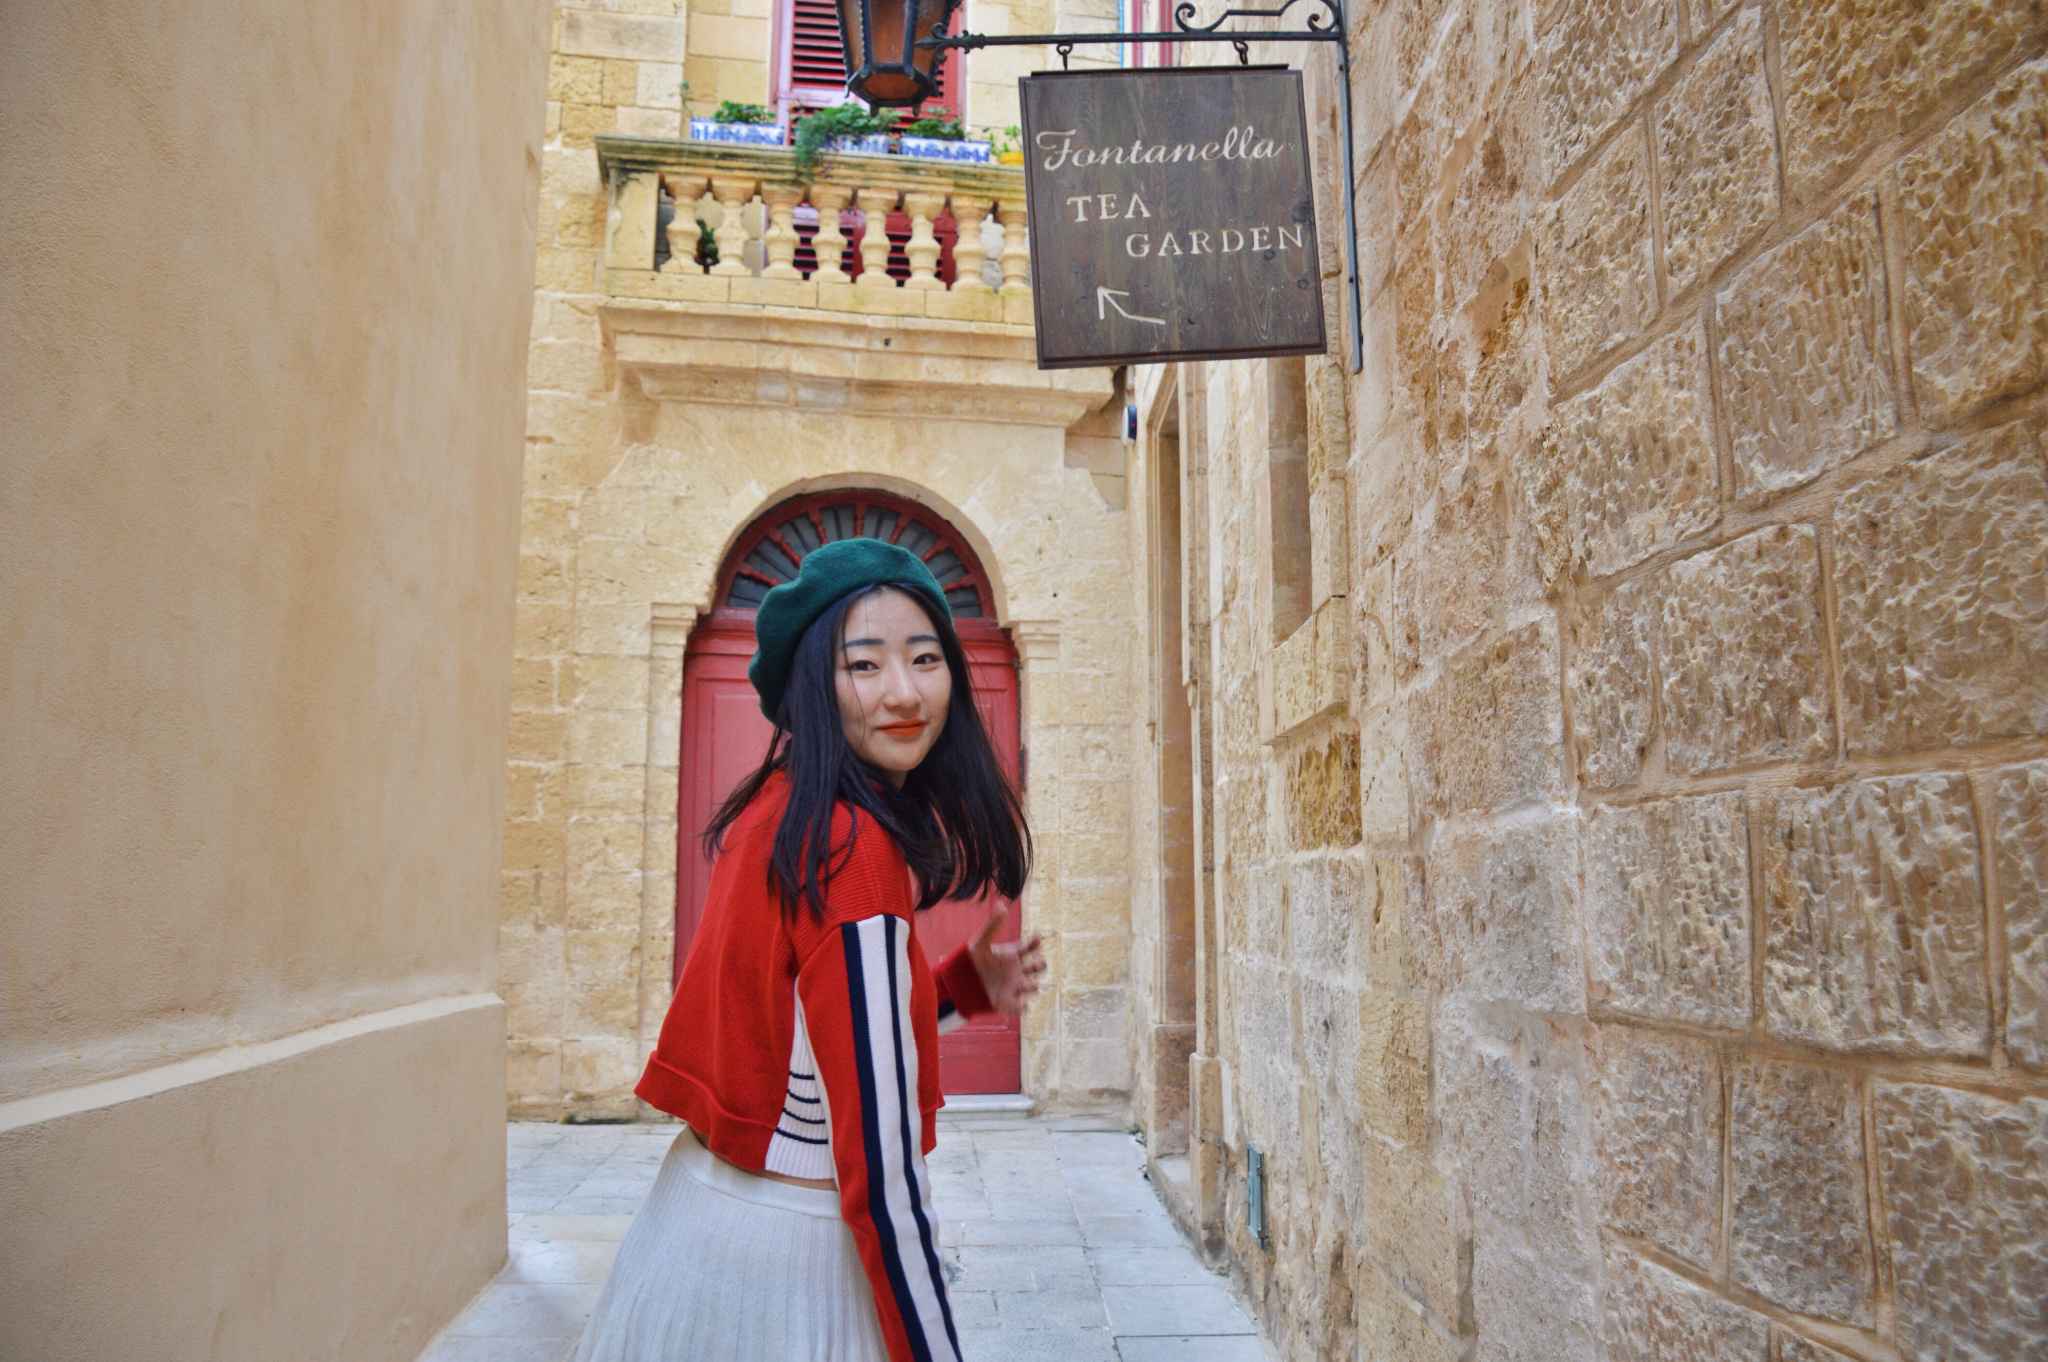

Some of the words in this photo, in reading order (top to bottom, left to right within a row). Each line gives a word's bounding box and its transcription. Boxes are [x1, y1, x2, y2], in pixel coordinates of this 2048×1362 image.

[1036, 125, 1283, 171] Fontanella
[1066, 193, 1151, 223] TEA
[1125, 225, 1304, 258] GARDEN
